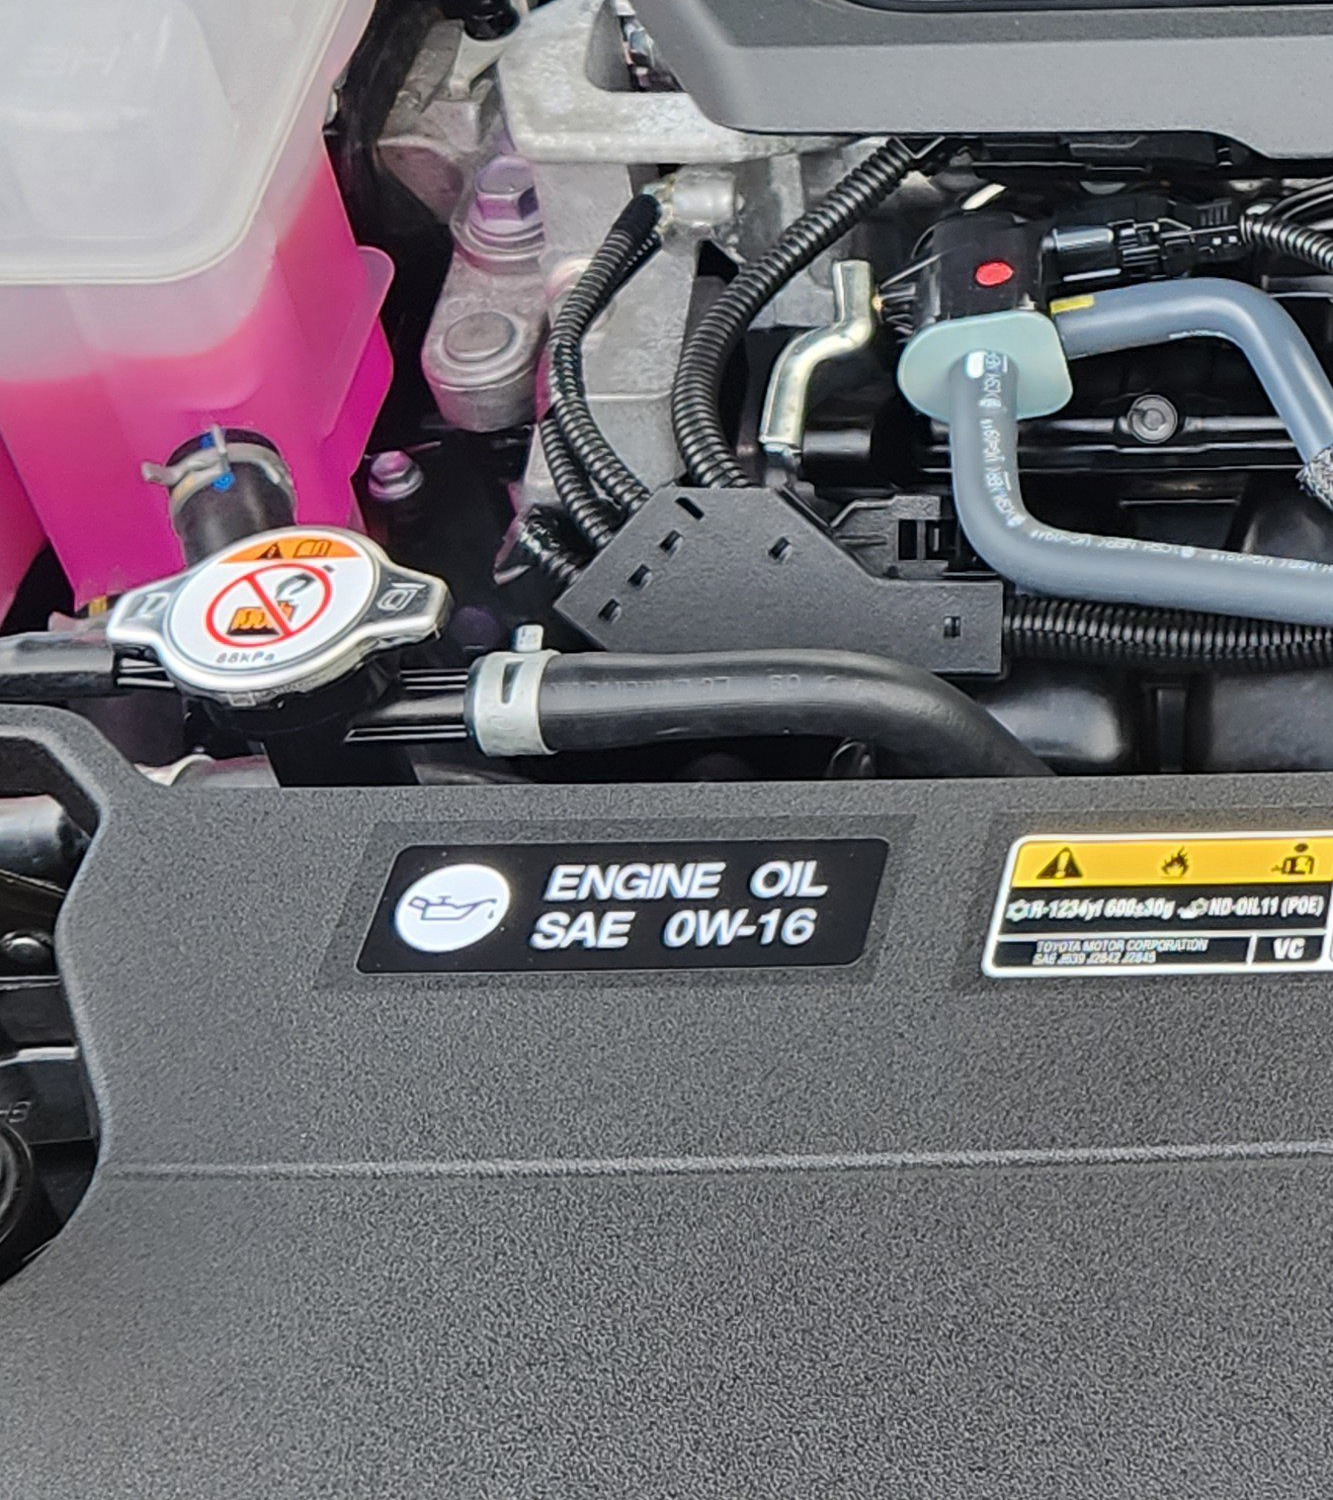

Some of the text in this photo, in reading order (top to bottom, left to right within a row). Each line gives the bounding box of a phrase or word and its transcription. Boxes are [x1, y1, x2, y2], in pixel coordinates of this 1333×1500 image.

[543, 859, 829, 901] ENGINE OIL
[1281, 895, 1325, 917] (POE)
[530, 908, 819, 950] SAE 0W-16
[1036, 938, 1209, 953] TOYOTA MOTOR CORPORATION
[1273, 938, 1306, 959] VC
